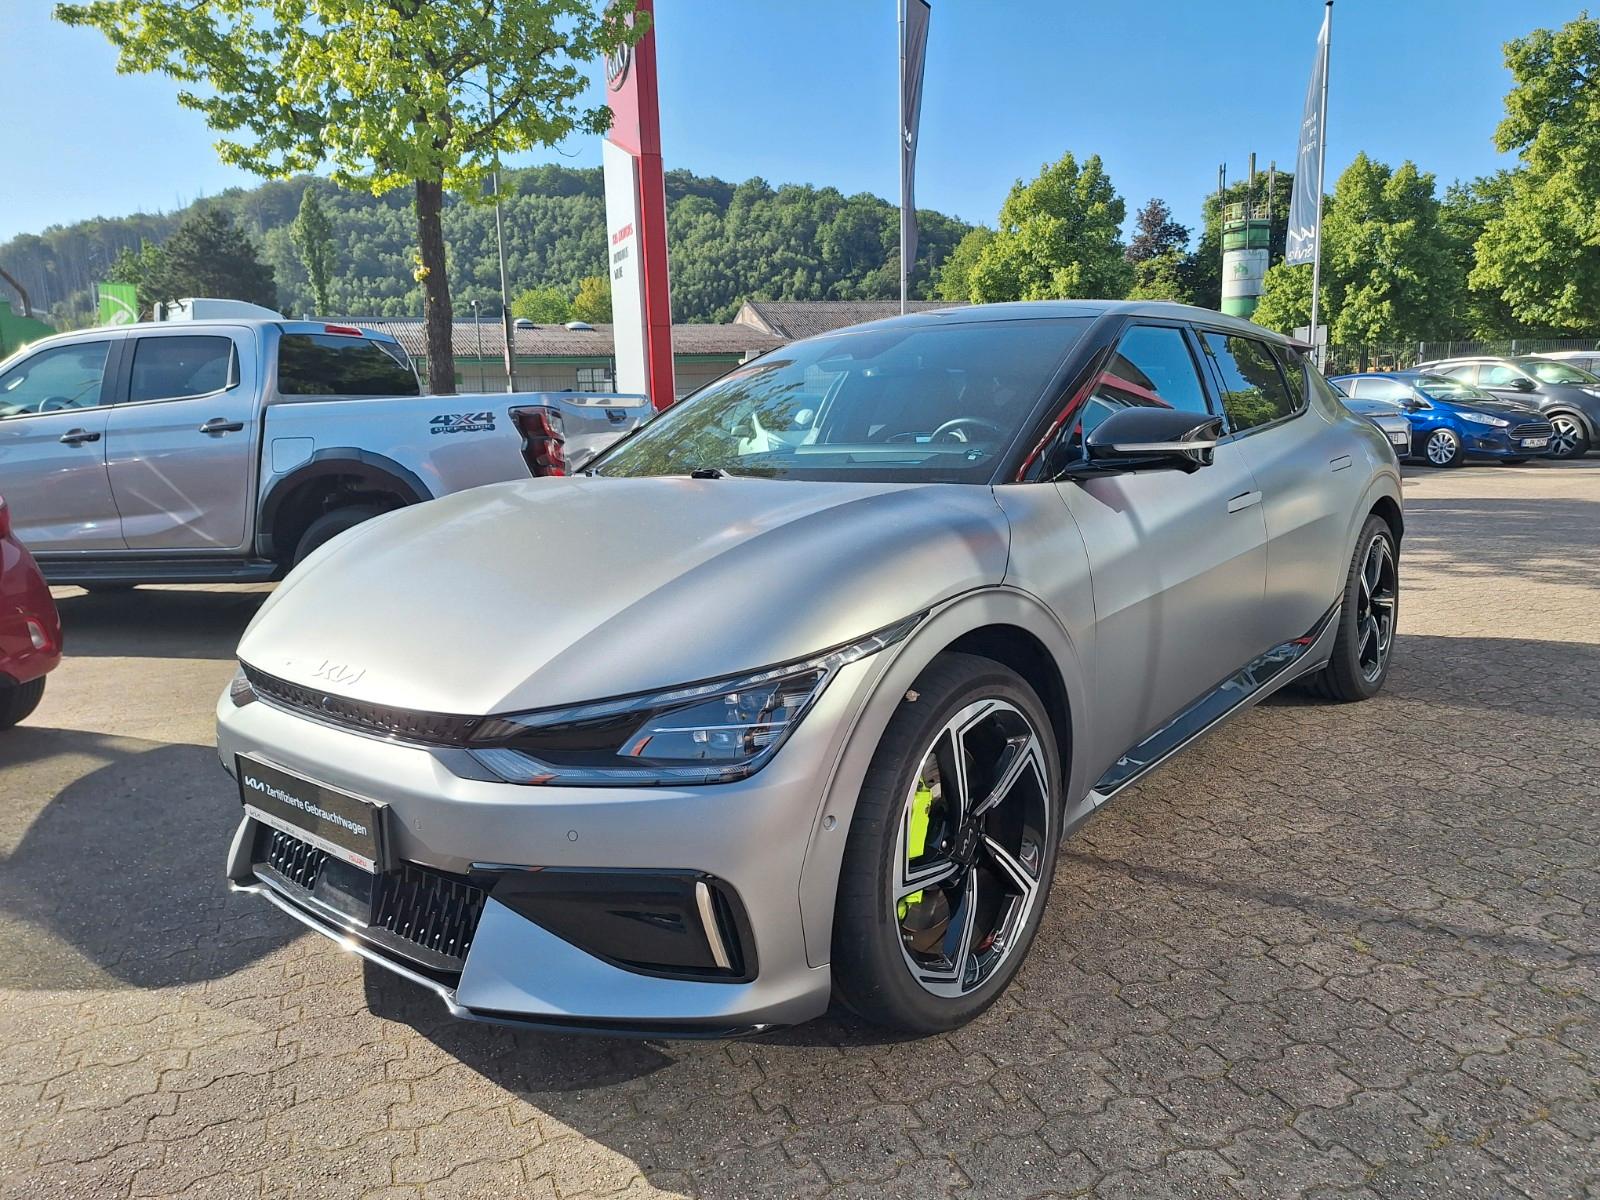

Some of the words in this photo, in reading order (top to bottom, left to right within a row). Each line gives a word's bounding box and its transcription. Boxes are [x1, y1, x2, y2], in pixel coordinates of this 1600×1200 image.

[312, 659, 366, 685] KIA
[244, 775, 265, 793] KIA
[265, 784, 304, 810] Zertifizierte
[304, 801, 367, 836] Gebrauchtwagen
